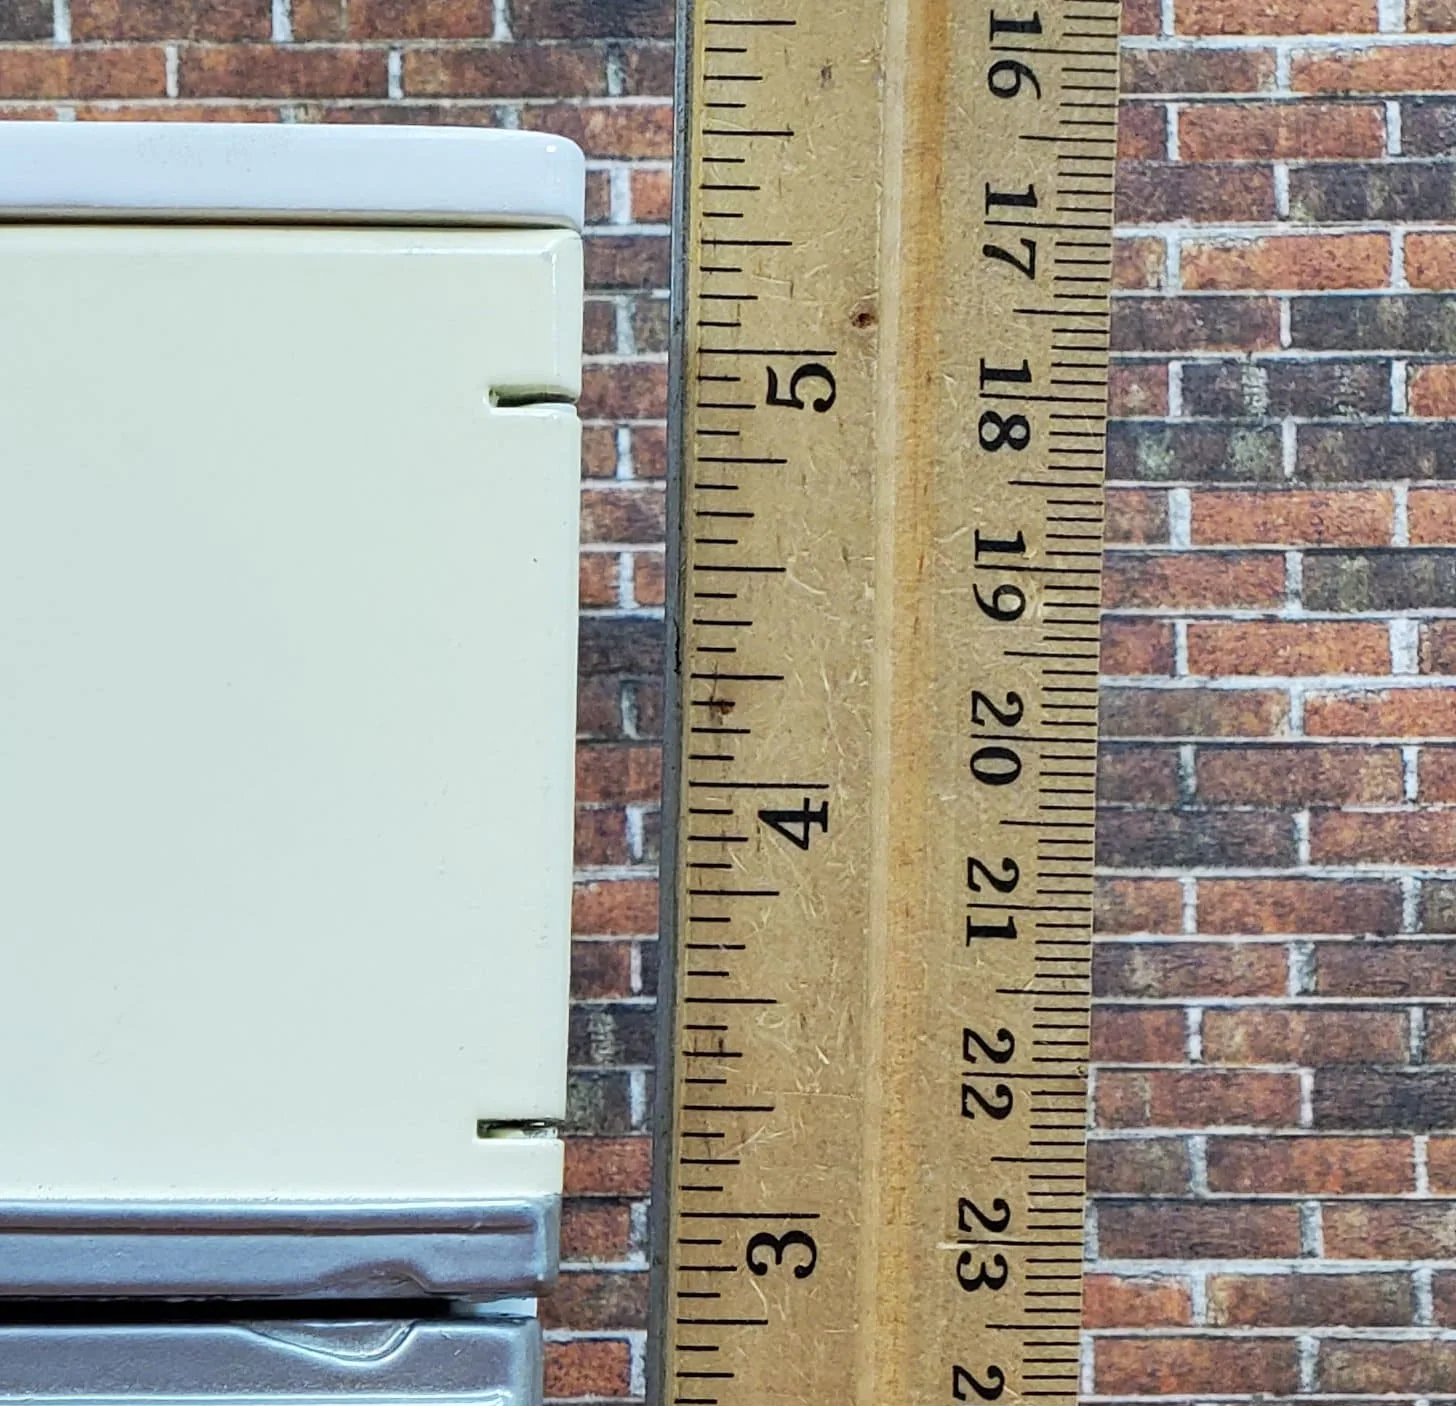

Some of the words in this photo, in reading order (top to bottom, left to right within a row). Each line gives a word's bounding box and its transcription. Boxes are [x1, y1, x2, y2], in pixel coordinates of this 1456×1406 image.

[987, 10, 1042, 99] 16
[982, 182, 1038, 280] 17
[765, 363, 837, 413] 5
[978, 358, 1032, 452] 18
[972, 529, 1026, 621] 19
[970, 691, 1024, 786] 20
[758, 798, 828, 850] 4
[966, 856, 1019, 947] 21
[961, 1028, 1015, 1120] 22
[746, 1230, 817, 1279] 3
[956, 1198, 1010, 1292] 23
